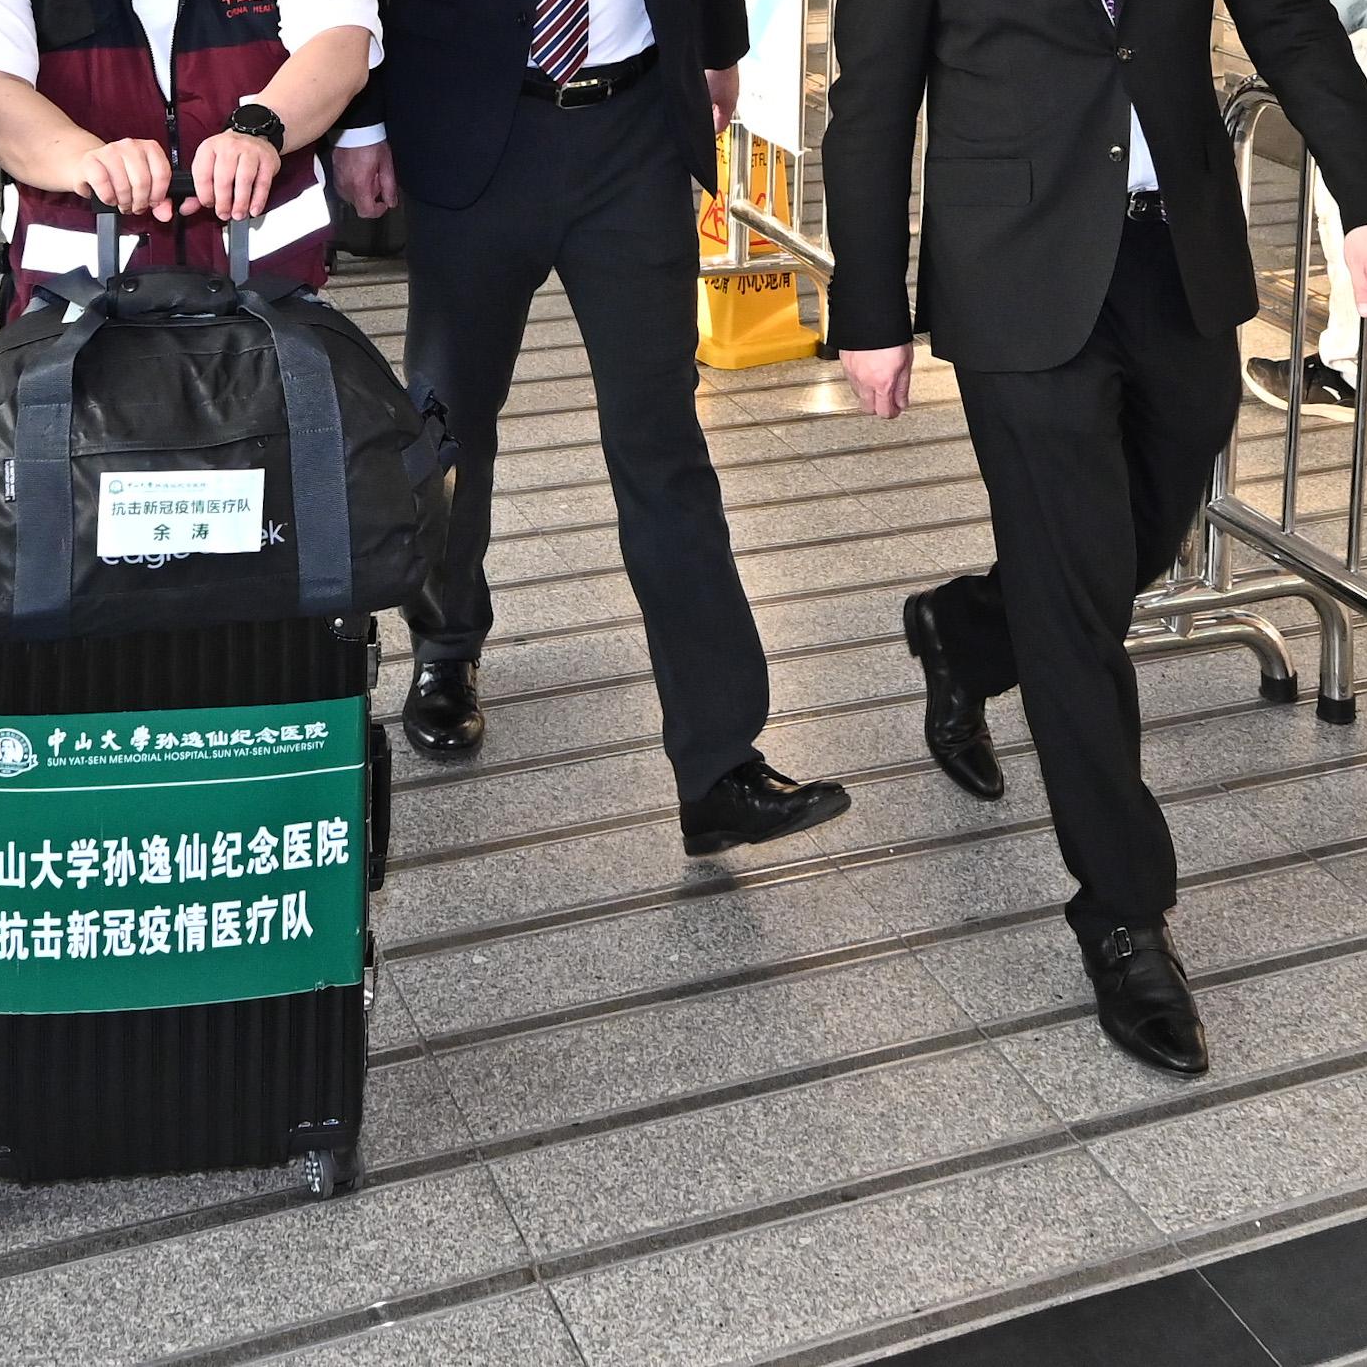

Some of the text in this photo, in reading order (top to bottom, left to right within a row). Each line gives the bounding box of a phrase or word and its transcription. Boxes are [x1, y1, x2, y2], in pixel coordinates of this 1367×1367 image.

[111, 498, 251, 516] 抗击新冠疫情医疗队
[153, 523, 209, 541] 余 涛
[47, 756, 67, 767] SUN
[68, 755, 107, 765] YAT-SEN
[108, 753, 162, 764] MEMORIAL
[233, 746, 271, 757] YAT-SEN
[272, 740, 325, 754] UNIVERSITY
